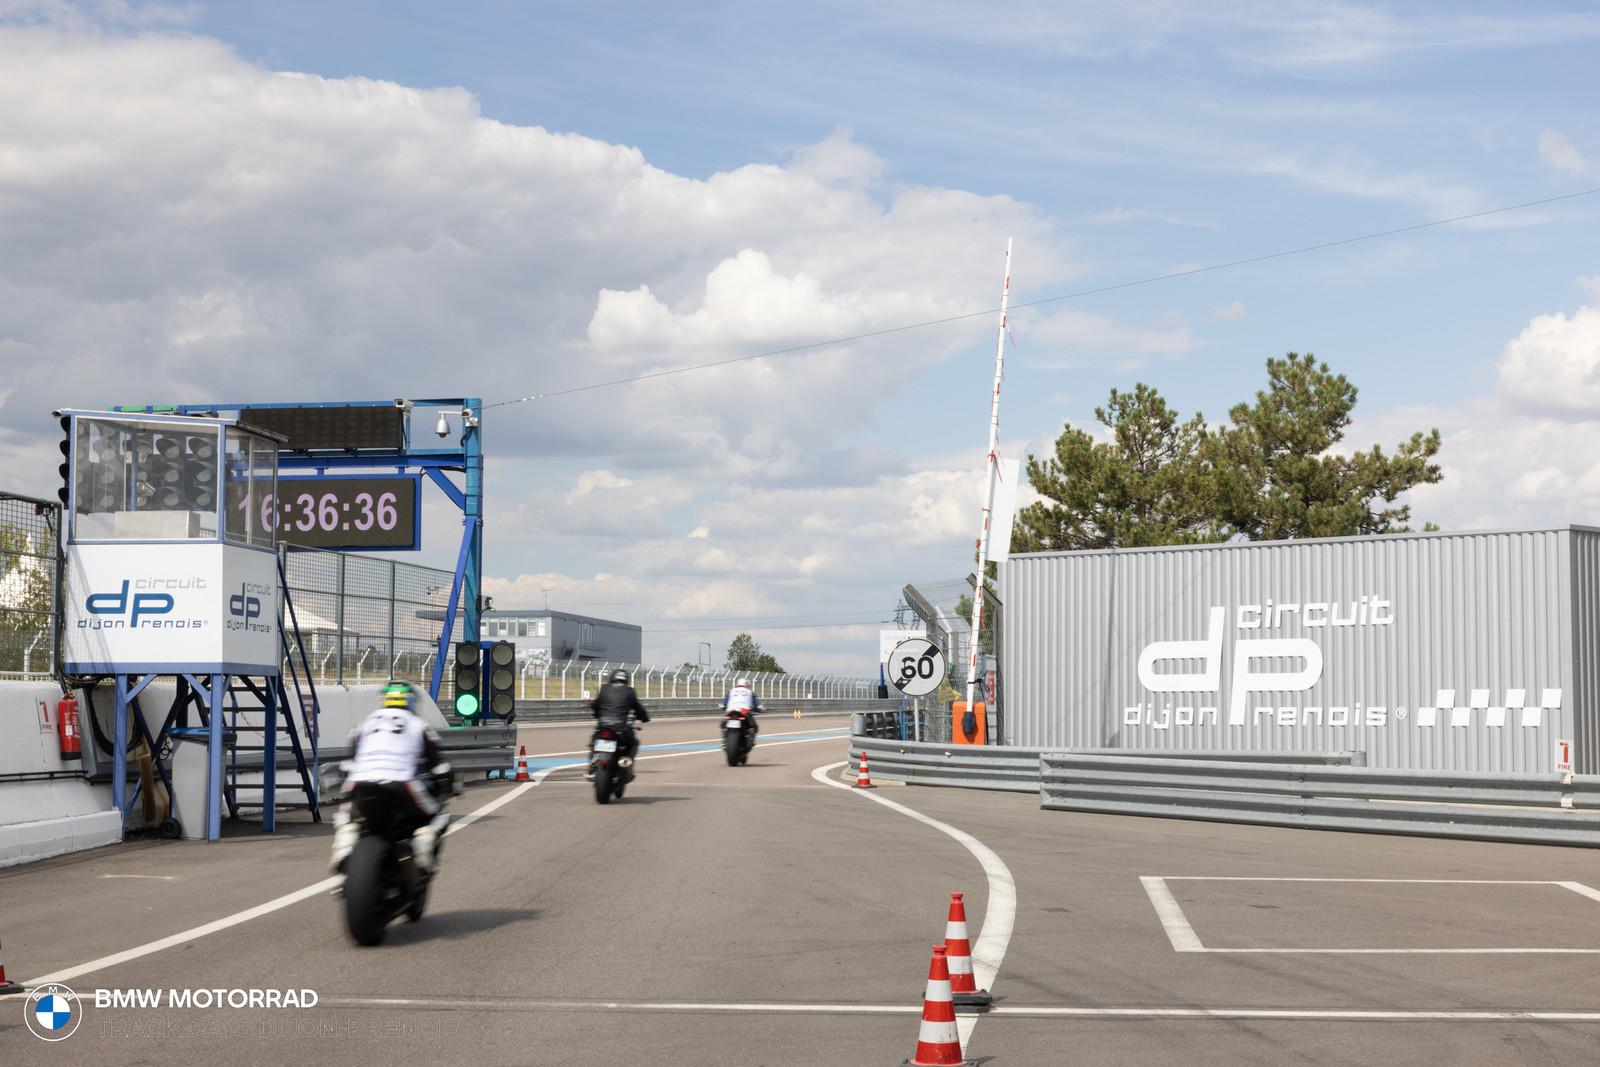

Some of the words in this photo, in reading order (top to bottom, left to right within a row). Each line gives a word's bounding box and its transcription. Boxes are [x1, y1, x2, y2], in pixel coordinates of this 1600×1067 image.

[238, 492, 398, 533] 16:36:36
[135, 576, 207, 589] circuit
[246, 582, 271, 595] circuit
[1236, 594, 1396, 628] circuit
[77, 618, 125, 630] dijon
[901, 656, 934, 679] 60
[1123, 702, 1218, 729] dijon
[1557, 763, 1571, 771] FIRE
